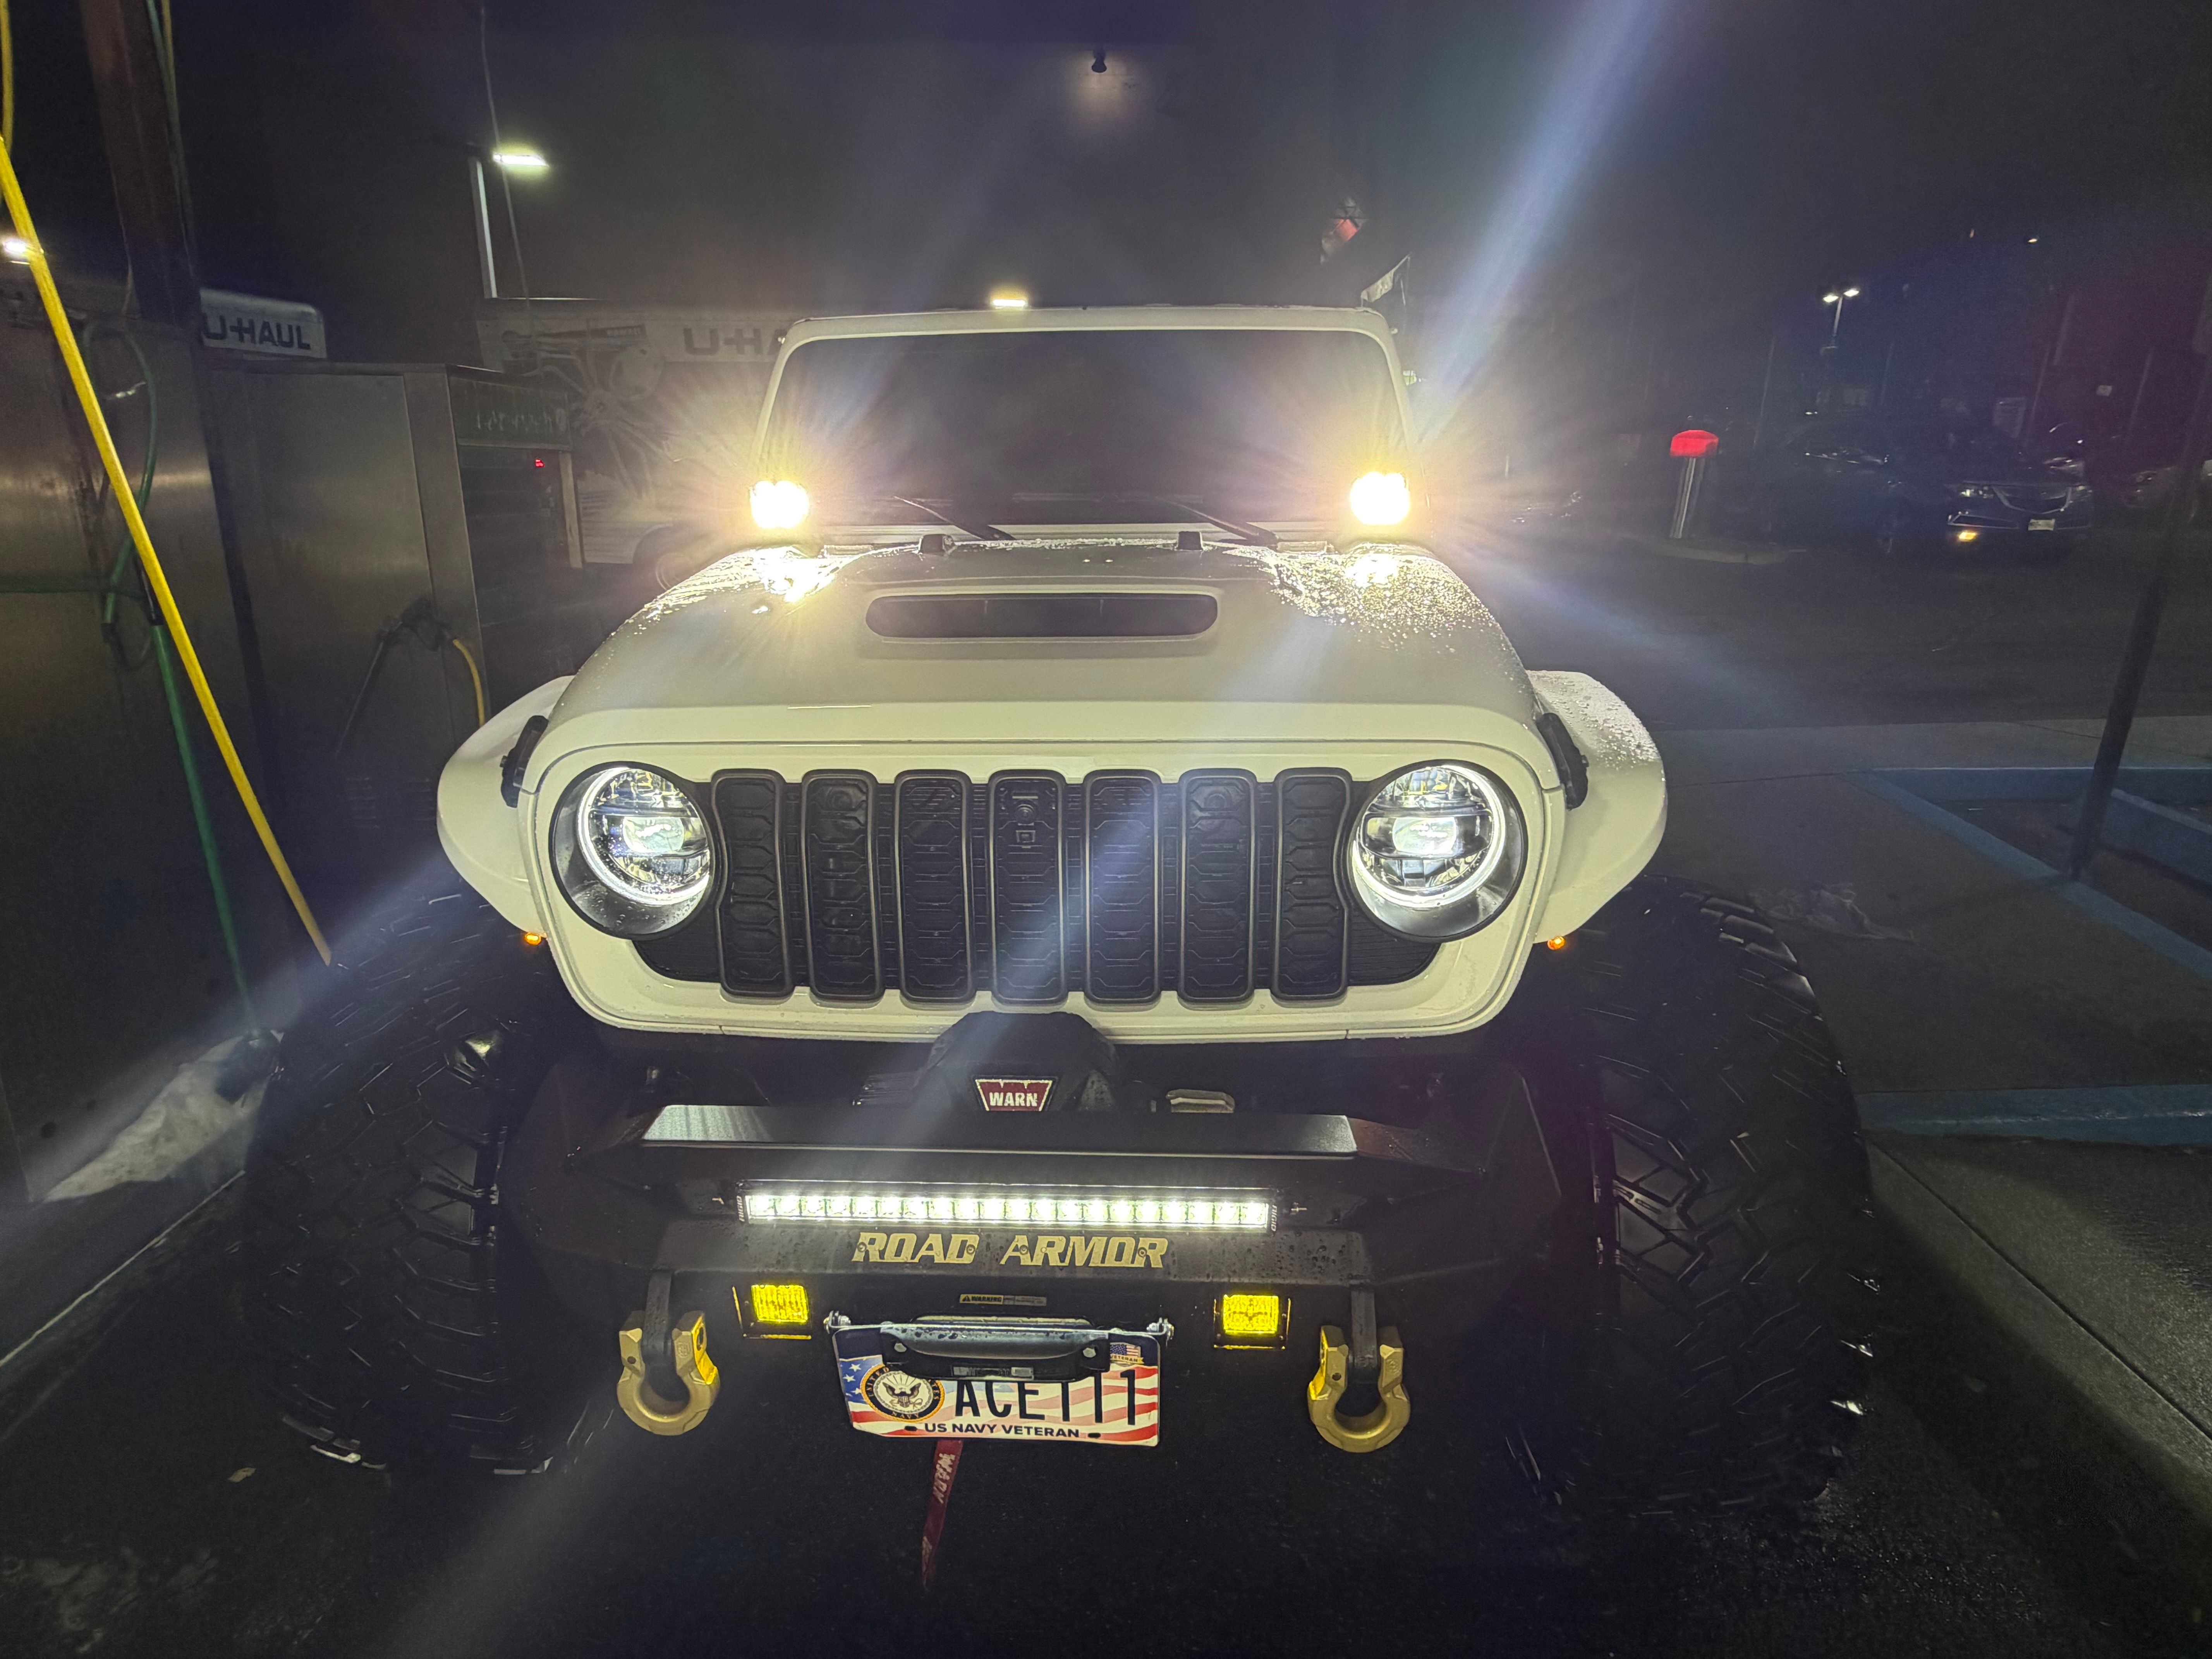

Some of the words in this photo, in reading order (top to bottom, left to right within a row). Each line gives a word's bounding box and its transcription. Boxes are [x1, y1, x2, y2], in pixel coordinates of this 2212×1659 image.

[203, 313, 311, 350] U-HAUL
[989, 1092, 1039, 1107] WARN
[852, 1231, 980, 1264] ROAD
[999, 1235, 1168, 1269] ARMOR
[891, 1411, 919, 1421] NAVY
[924, 1423, 947, 1432] US
[952, 1424, 998, 1433] NAVY
[1001, 1425, 1080, 1438] VETERAN
